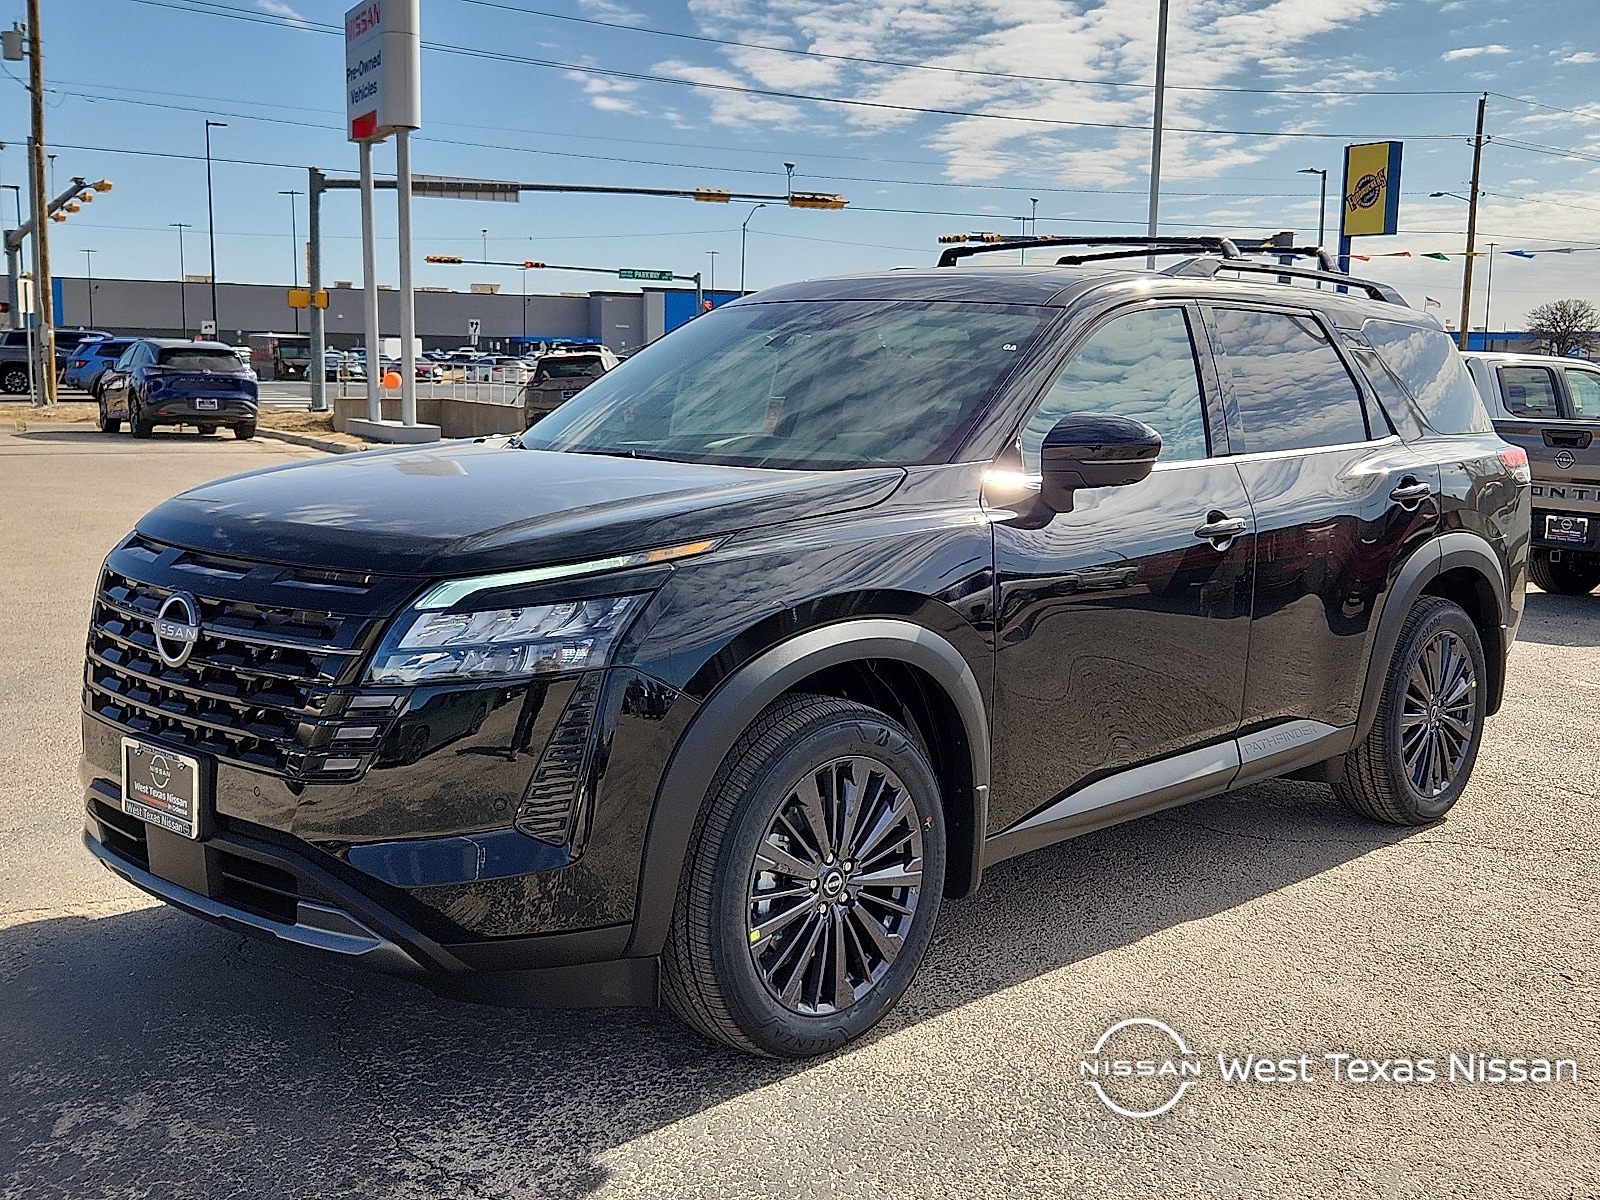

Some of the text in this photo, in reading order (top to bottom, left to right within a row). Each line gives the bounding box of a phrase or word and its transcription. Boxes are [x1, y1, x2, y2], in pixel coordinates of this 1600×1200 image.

[347, 4, 380, 41] NISSAN
[347, 50, 381, 83] Pre-Owned
[351, 81, 377, 105] Vehicles
[634, 271, 660, 279] PARKWAY
[154, 619, 196, 639] SSAN
[1242, 724, 1318, 756] PATHFINDER
[150, 765, 171, 778] NISSAN
[134, 781, 188, 808] West Texas Nissan
[127, 802, 143, 816] West
[143, 808, 160, 823] Texas
[161, 816, 183, 833] Nissan
